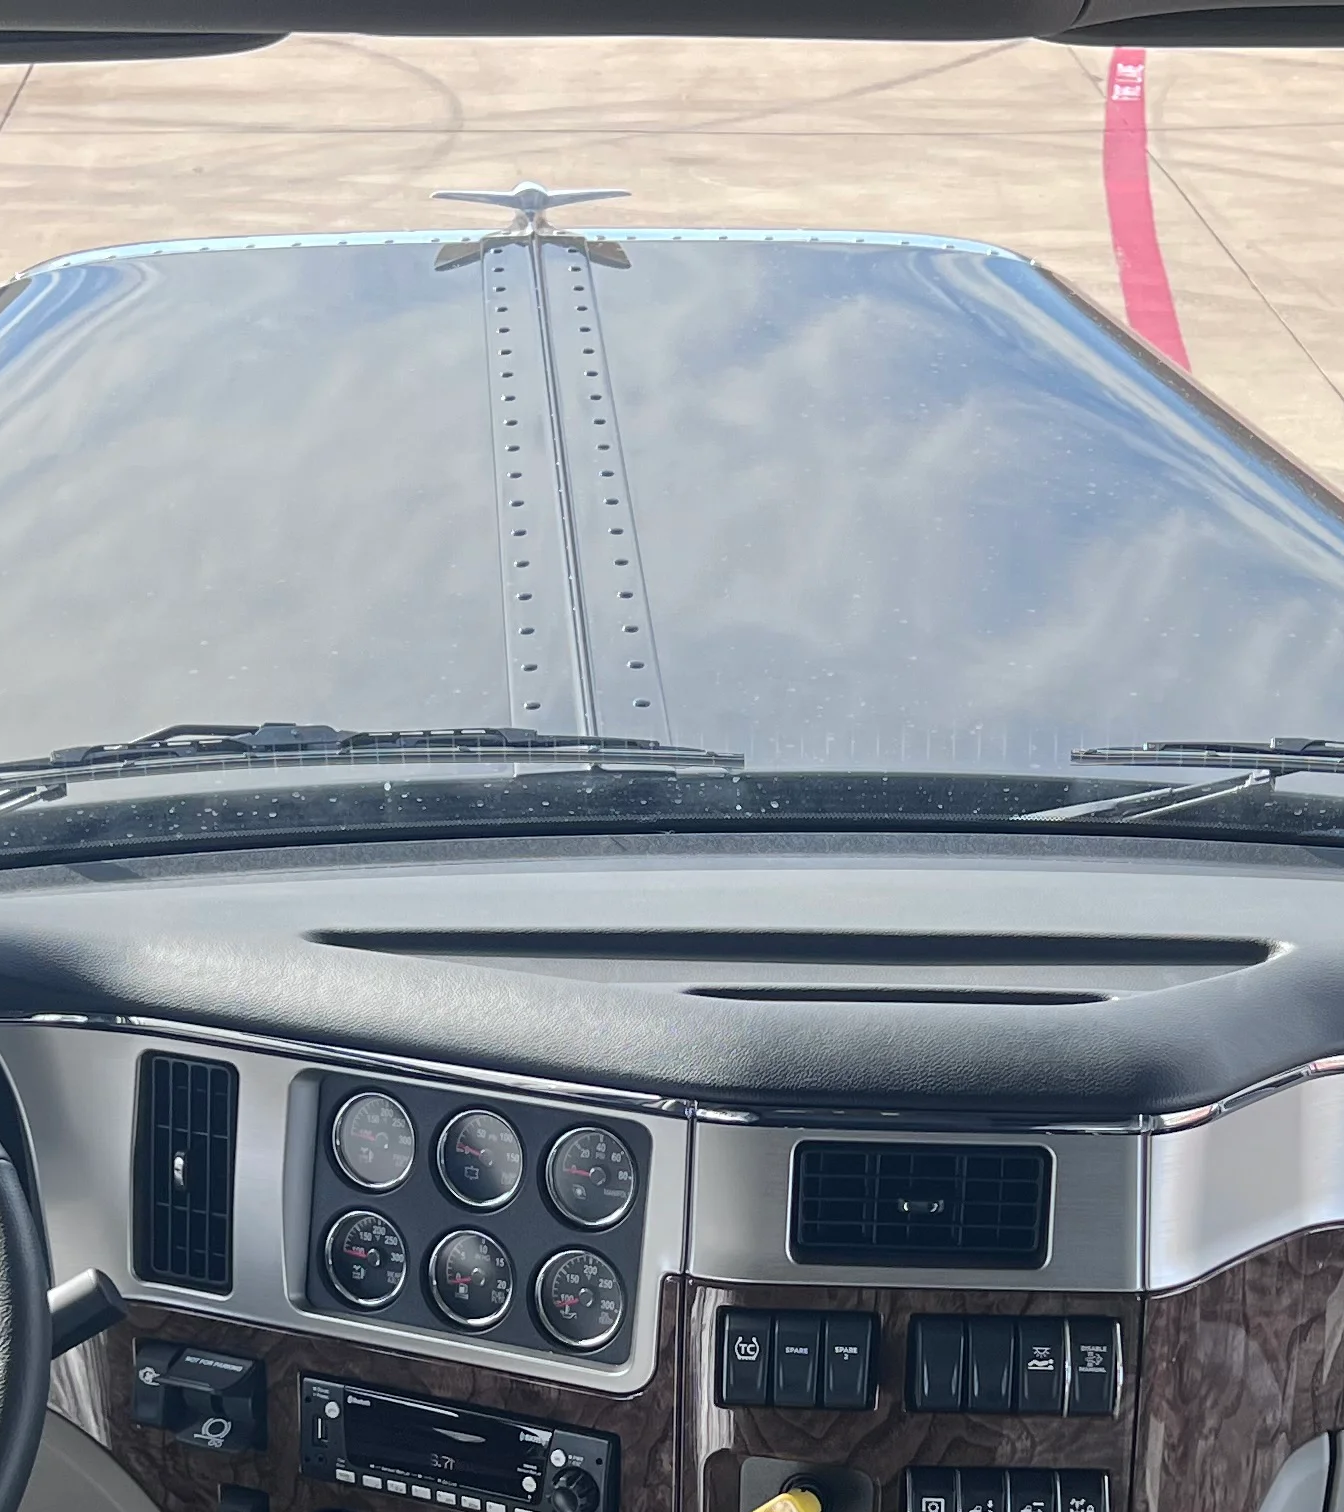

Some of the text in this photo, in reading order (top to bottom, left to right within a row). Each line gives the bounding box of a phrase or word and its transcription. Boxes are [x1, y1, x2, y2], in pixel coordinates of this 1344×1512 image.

[580, 1149, 590, 1158] 20
[359, 1232, 372, 1242] 150
[385, 1236, 398, 1246] 250
[495, 1258, 505, 1267] 15
[583, 1265, 597, 1276] 200
[566, 1274, 580, 1284] 150
[497, 1280, 507, 1289] 20
[598, 1279, 613, 1290] 250
[600, 1300, 614, 1311] 300
[739, 1343, 756, 1356] TC
[785, 1346, 809, 1355] SPARE
[834, 1346, 858, 1354] SPARE
